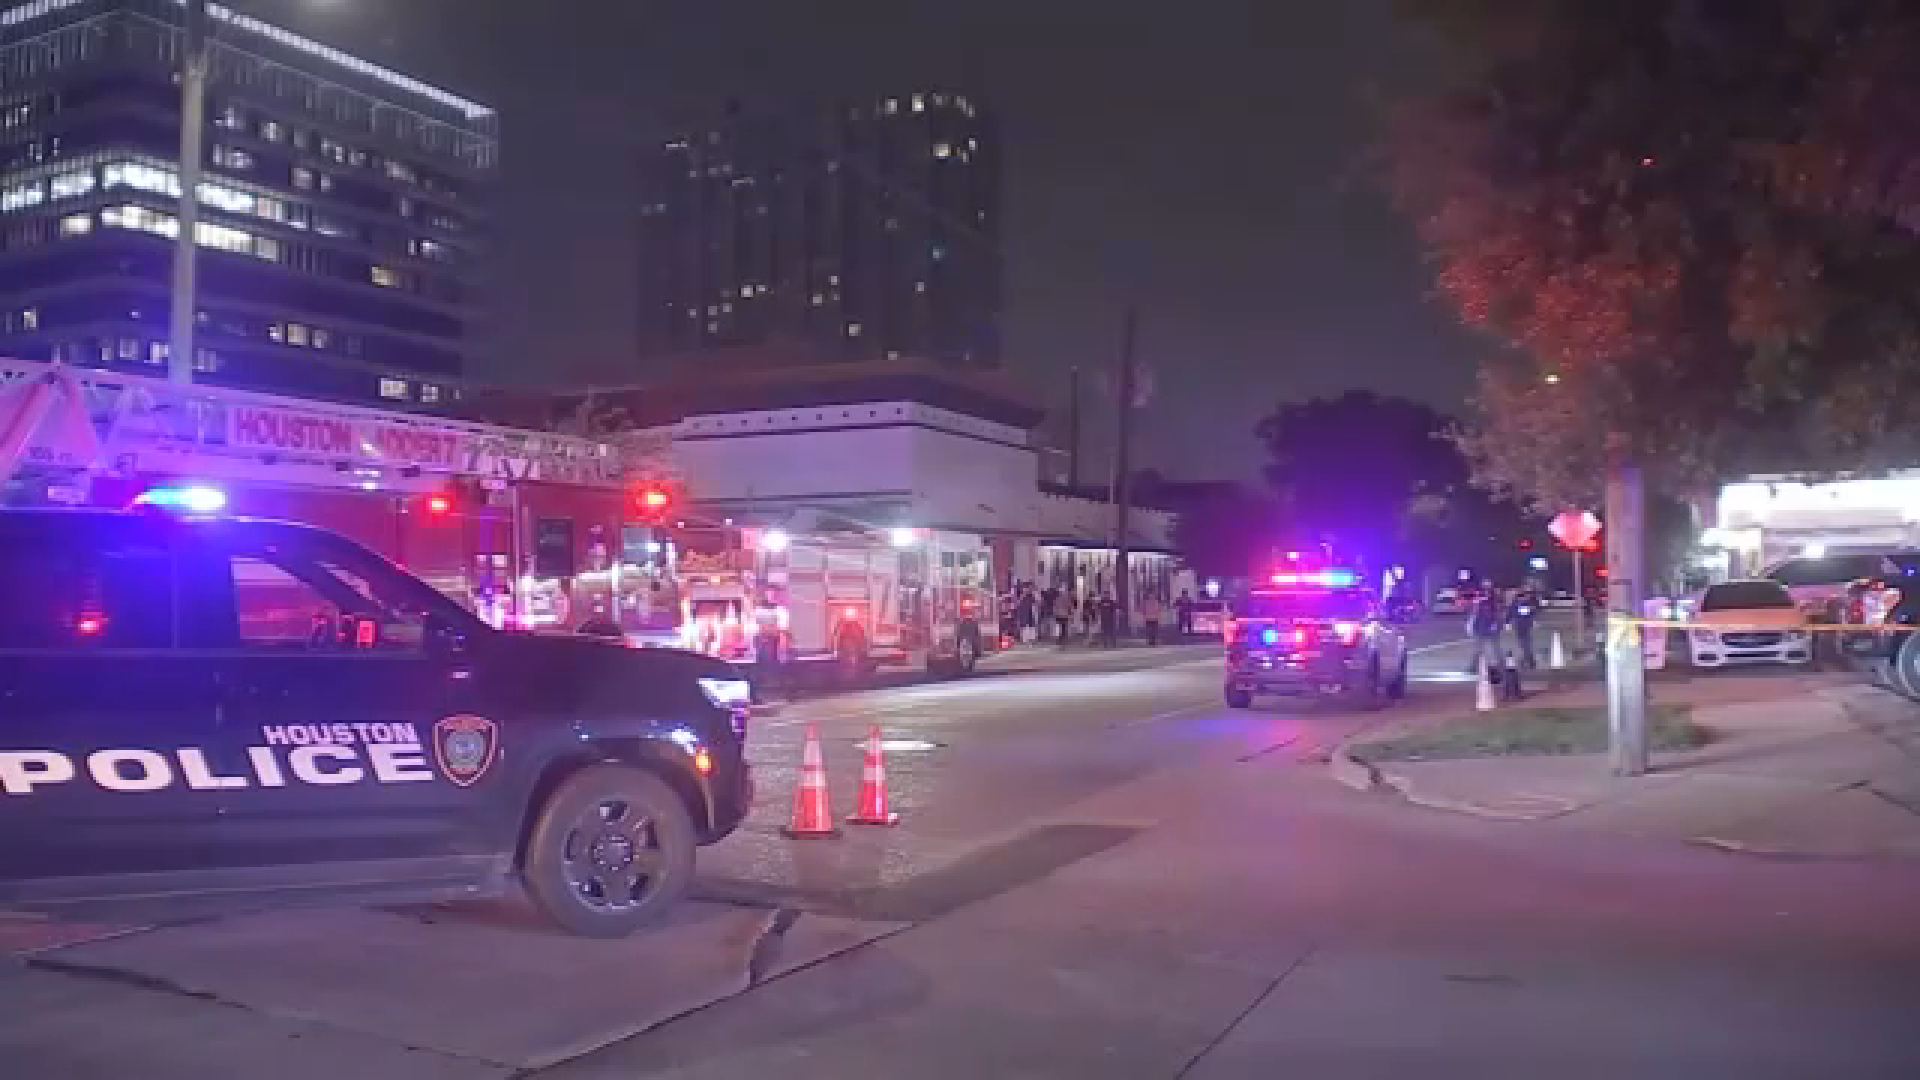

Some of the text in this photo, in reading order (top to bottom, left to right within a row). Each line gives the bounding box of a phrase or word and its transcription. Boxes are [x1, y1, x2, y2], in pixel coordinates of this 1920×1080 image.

[237, 407, 350, 453] HOUSTON
[262, 722, 418, 744] HOUSTON
[0, 744, 435, 793] POLICE
